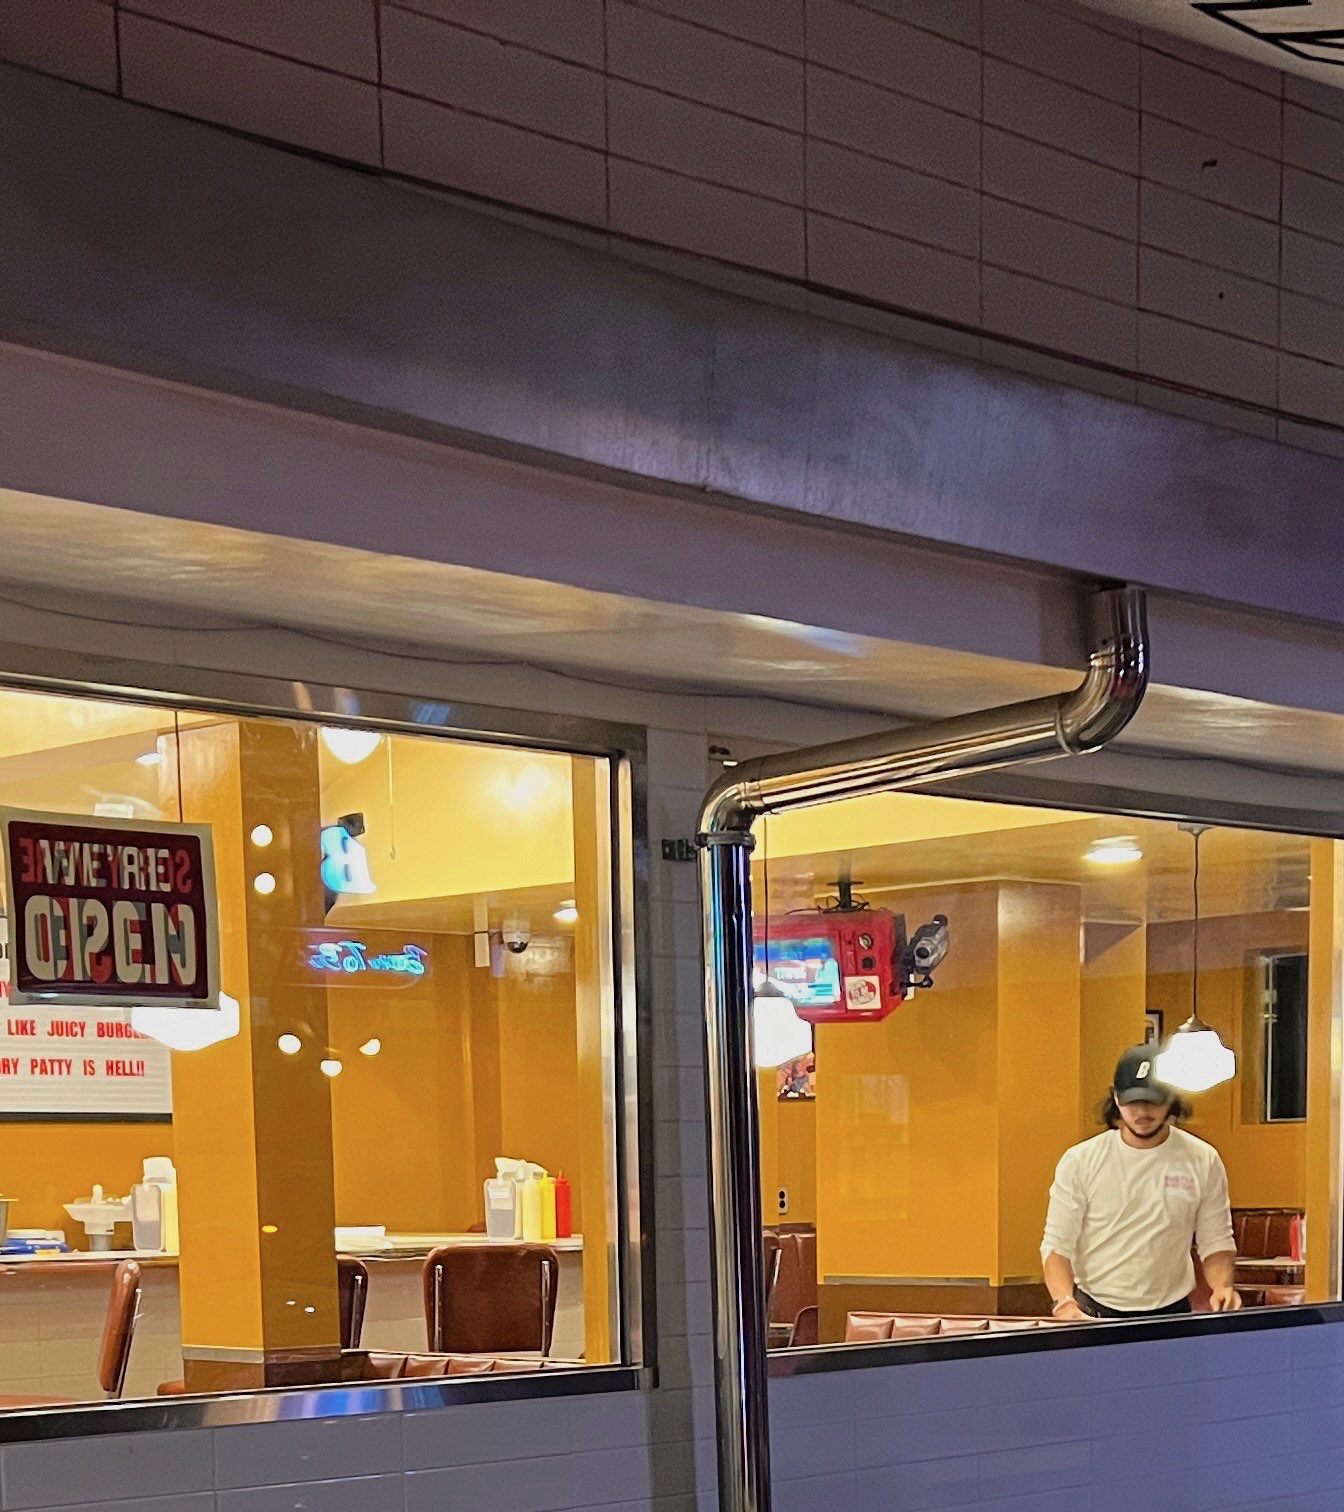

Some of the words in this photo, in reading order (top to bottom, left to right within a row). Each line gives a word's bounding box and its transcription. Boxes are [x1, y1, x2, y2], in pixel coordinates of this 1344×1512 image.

[7, 1019, 36, 1037] LIKE
[47, 1020, 86, 1038] JUICY
[30, 1059, 72, 1076] PATTY
[83, 1059, 96, 1076] IS
[106, 1060, 145, 1077] HELL!!
